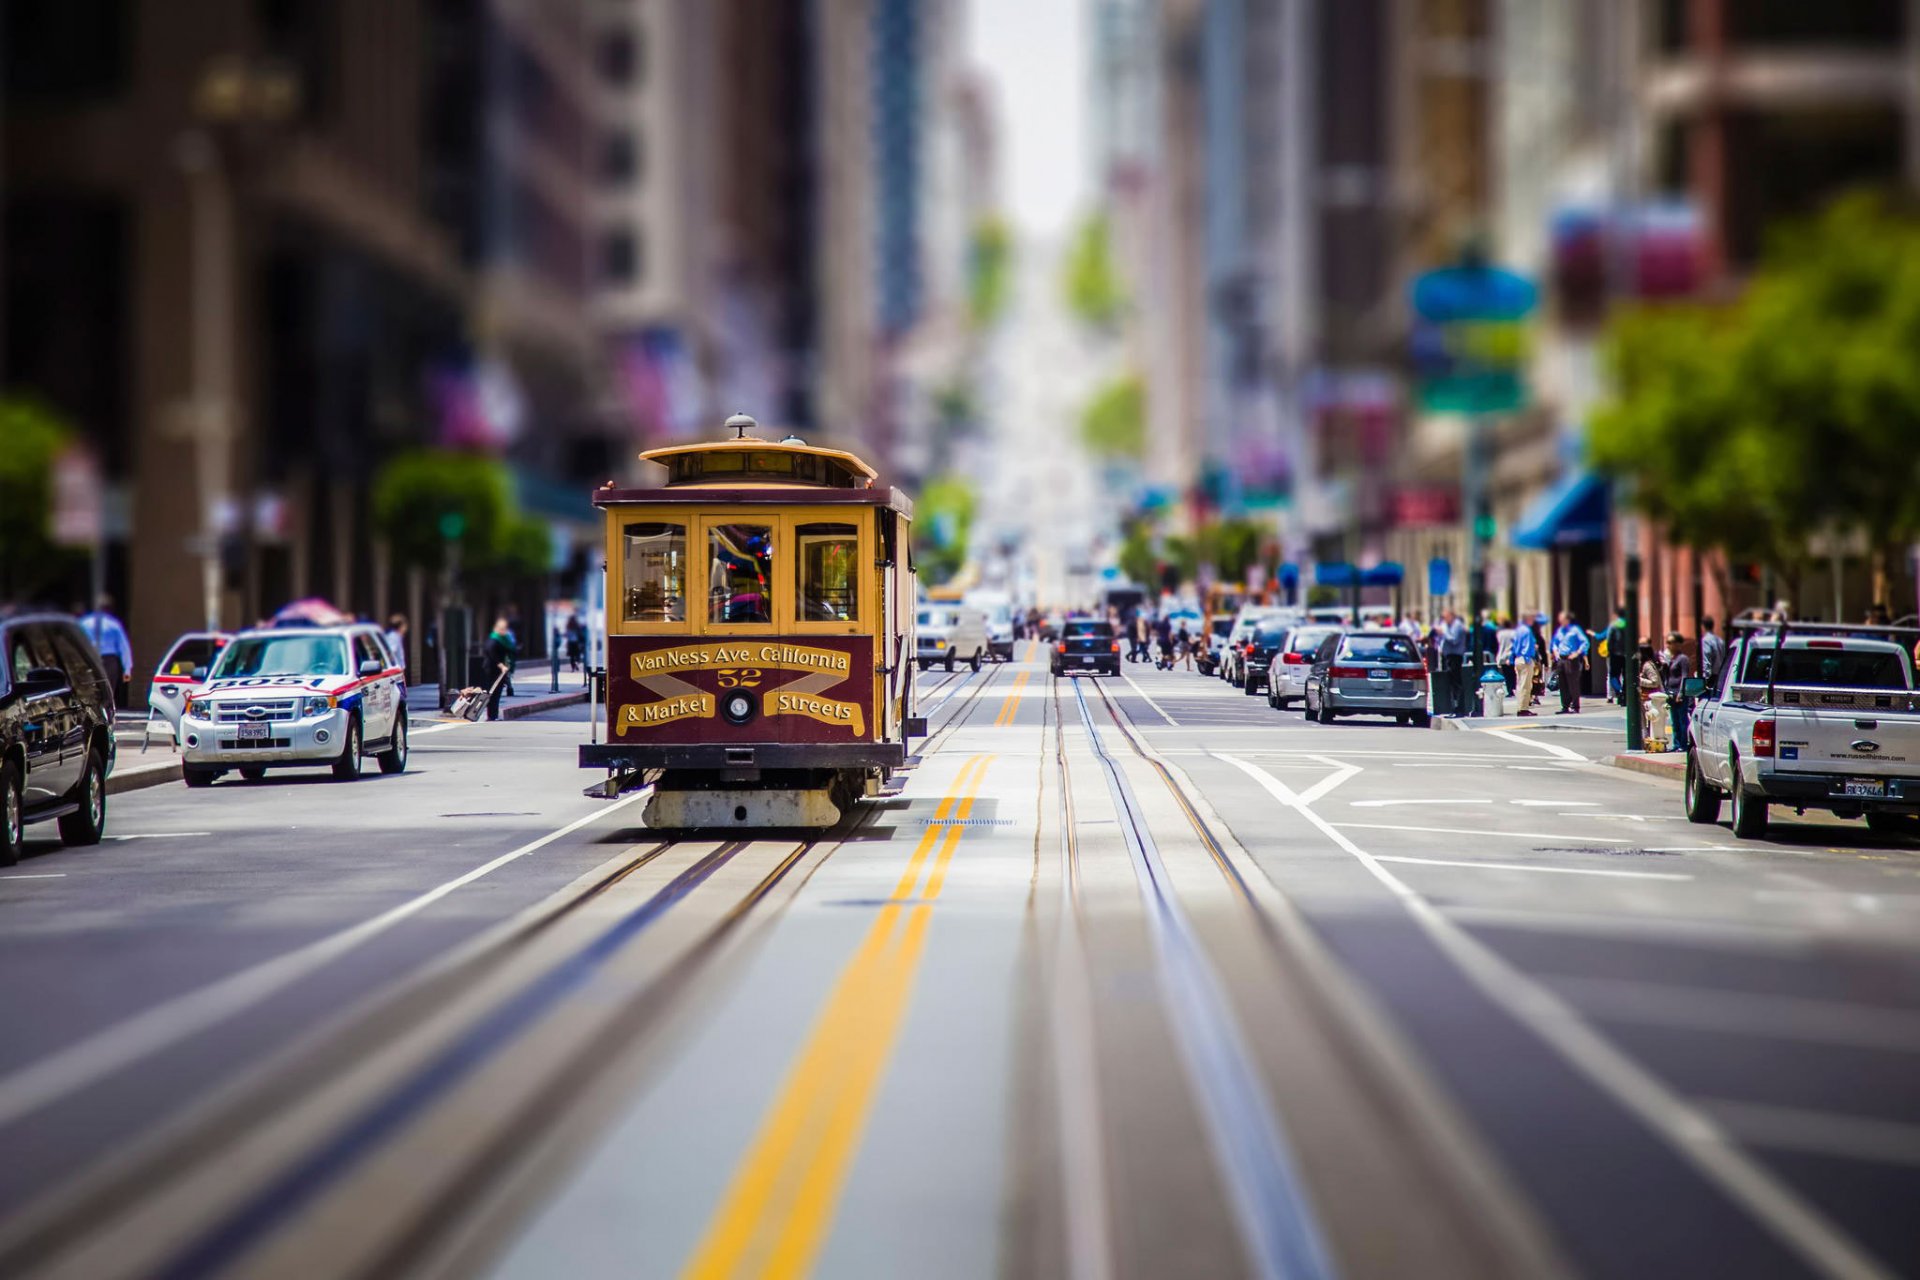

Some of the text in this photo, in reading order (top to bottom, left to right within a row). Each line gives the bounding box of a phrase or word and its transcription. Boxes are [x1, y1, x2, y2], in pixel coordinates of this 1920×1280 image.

[635, 655, 666, 671] Van
[667, 651, 709, 666] Ness
[761, 647, 847, 670] California
[717, 668, 762, 688] 52
[627, 698, 707, 721] & Market
[779, 694, 852, 719] Streets
